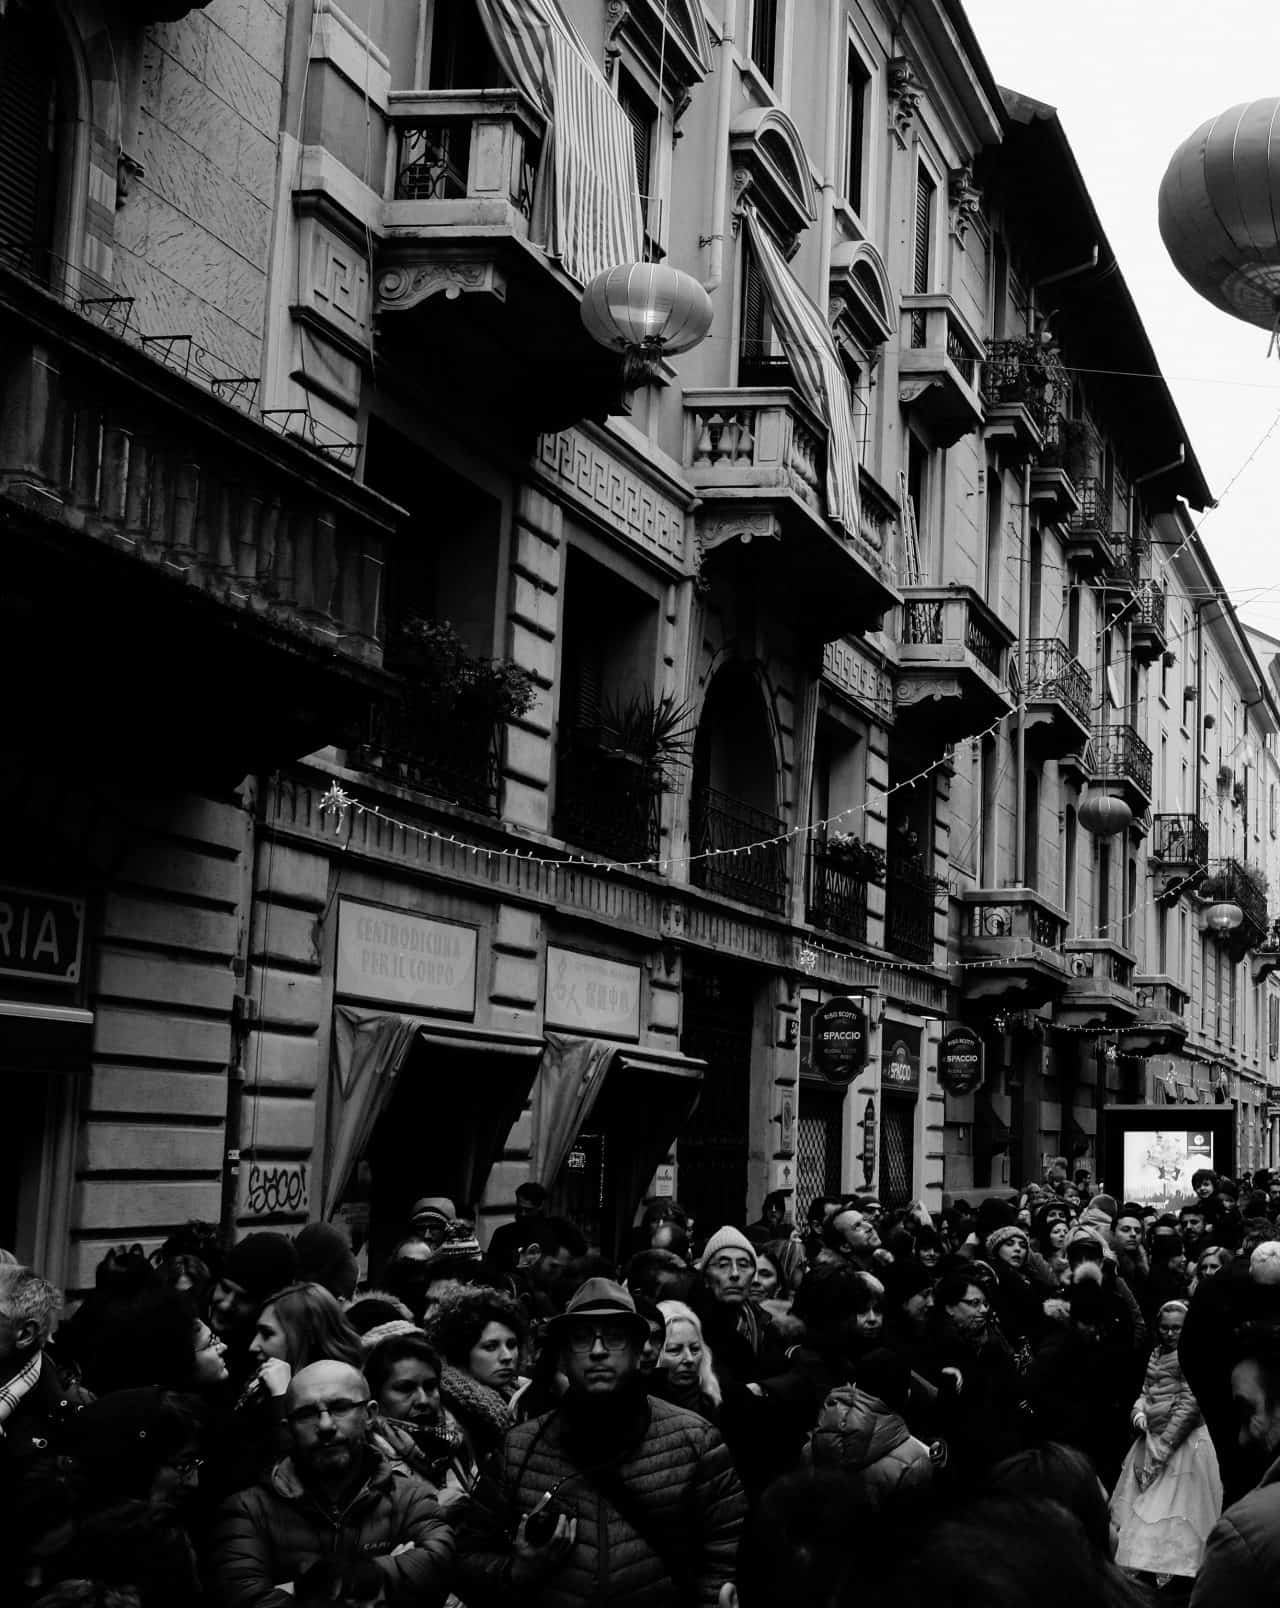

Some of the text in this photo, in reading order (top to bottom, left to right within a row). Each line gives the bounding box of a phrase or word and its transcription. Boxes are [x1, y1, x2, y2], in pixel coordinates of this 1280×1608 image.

[361, 949, 389, 977] PER
[409, 958, 455, 986] CORPO
[823, 1031, 861, 1040] SPACCIO
[946, 1055, 978, 1063] SPACCIO
